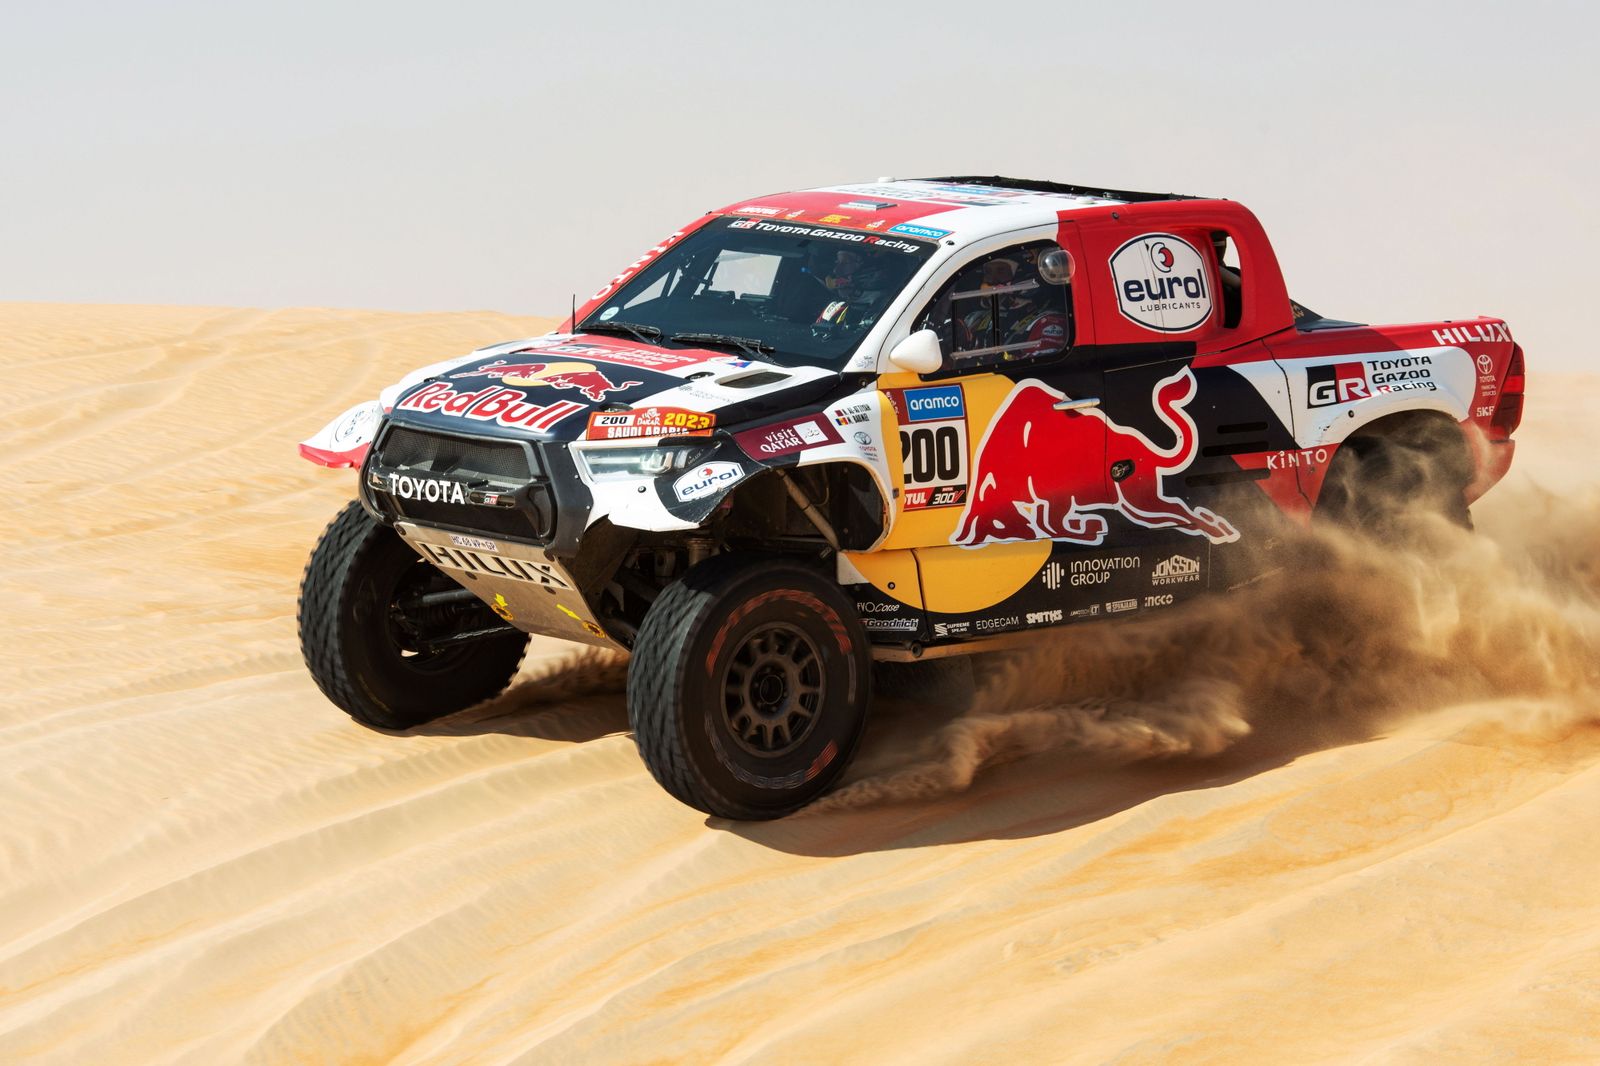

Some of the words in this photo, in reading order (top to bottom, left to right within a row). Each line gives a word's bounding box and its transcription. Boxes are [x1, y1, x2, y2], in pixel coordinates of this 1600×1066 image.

[756, 223, 811, 235] TOYOTA
[809, 229, 865, 243] GAZOO
[863, 235, 920, 253] Racing
[895, 225, 943, 237] aramco
[1123, 268, 1206, 302] eurol
[1140, 302, 1201, 312] LUBRICANTS
[1431, 323, 1511, 345] HILUX
[1309, 378, 1366, 406] GR
[1367, 356, 1432, 371] TOYOTA
[1372, 369, 1431, 384] GAZOO
[1376, 380, 1437, 392] Racing
[399, 382, 502, 415] Red
[471, 388, 584, 430] Bull
[910, 396, 959, 410] aramco
[1476, 406, 1495, 417] SKF
[601, 416, 628, 425] 200
[664, 413, 710, 430] 2023
[607, 427, 641, 438] SAUDI
[765, 428, 795, 442] visit
[760, 437, 802, 453] QATAR
[389, 473, 465, 505] TOYOTA
[682, 469, 737, 496] eurol
[419, 543, 569, 588] HILUX
[1071, 556, 1140, 573] INNOVATION
[1152, 555, 1200, 577] JONSSON
[1071, 572, 1111, 586] GROUP
[1152, 574, 1200, 586] WORKWEAR
[976, 616, 1019, 630] EDGECAM
[1026, 609, 1063, 624] SMITHS
